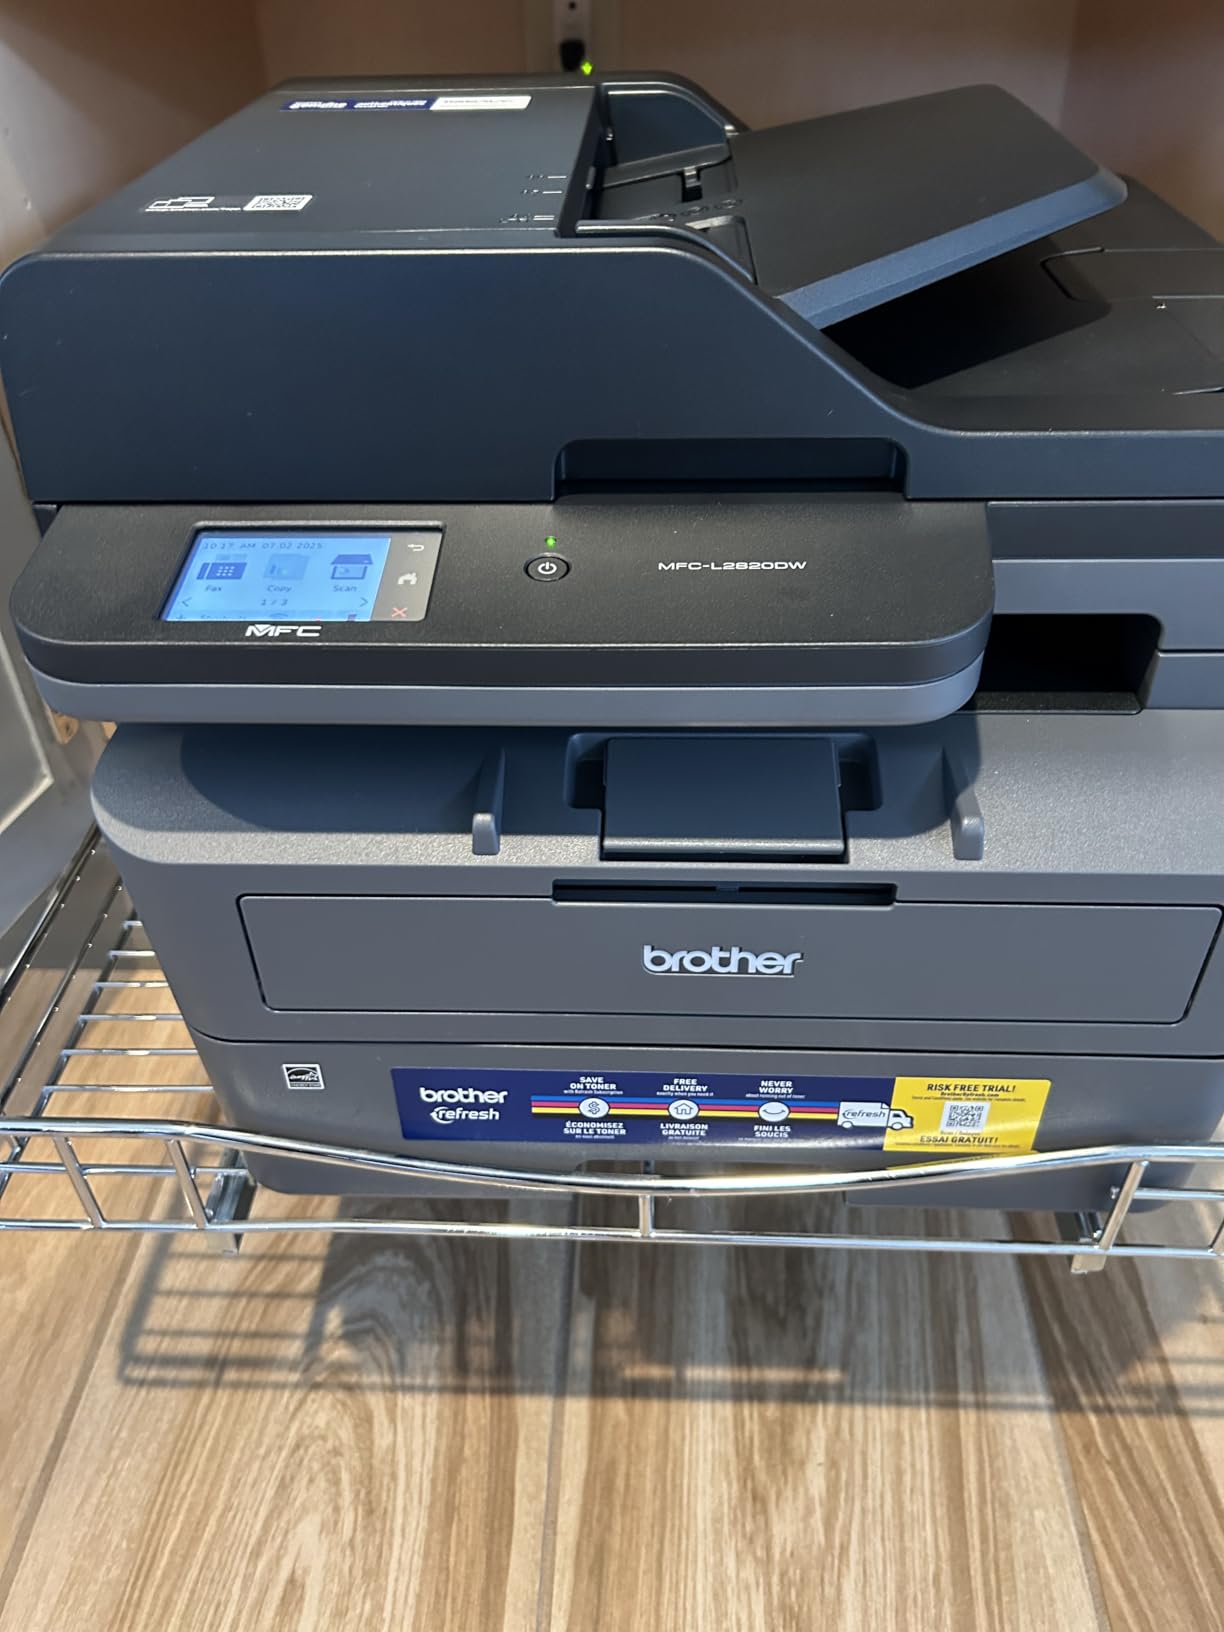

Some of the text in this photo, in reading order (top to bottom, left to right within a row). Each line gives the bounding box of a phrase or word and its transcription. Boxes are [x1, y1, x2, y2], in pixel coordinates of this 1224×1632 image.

[658, 561, 807, 571] MFC-L2820DW
[266, 585, 293, 593] Copy
[244, 624, 322, 638] MFC
[642, 944, 804, 979] brother
[569, 1082, 584, 1090] ON
[662, 1084, 708, 1092] DELIVERY
[926, 1083, 1016, 1093] RISK FREE TRIAL!
[419, 1087, 508, 1104] brother
[430, 1107, 500, 1124] refresh
[843, 1108, 887, 1119] refresh
[565, 1120, 624, 1129] ÉCONOMISEZ
[659, 1122, 709, 1130] LIVRAISON
[920, 1135, 999, 1144] ESSAI GRATUIT!
